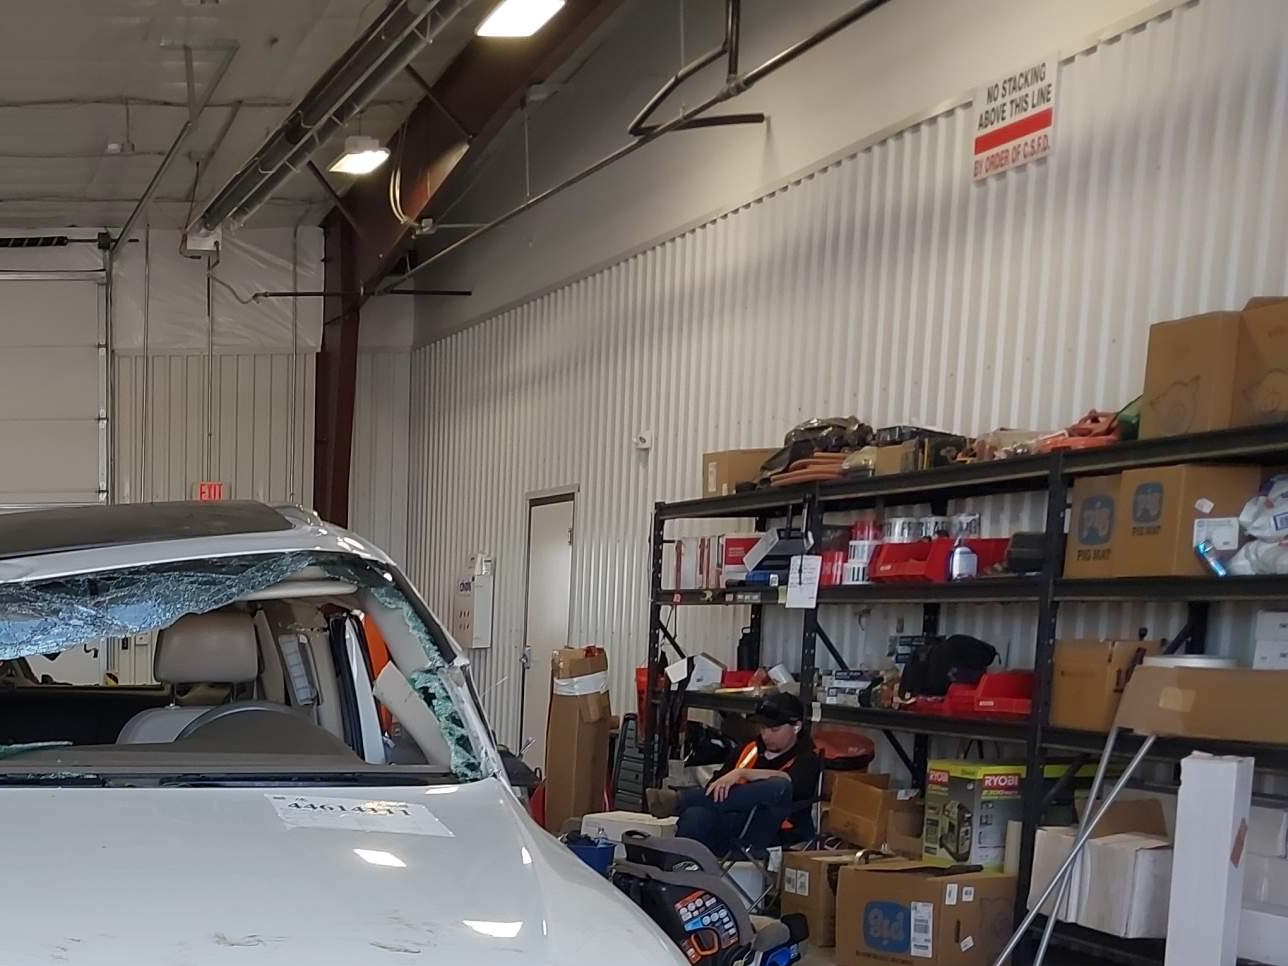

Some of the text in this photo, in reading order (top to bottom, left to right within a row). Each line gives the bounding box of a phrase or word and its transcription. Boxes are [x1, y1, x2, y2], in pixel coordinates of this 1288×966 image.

[986, 62, 1046, 105] NO STACKING
[978, 83, 1052, 130] ABOVE THIS LINE
[974, 160, 983, 178] BY
[984, 148, 1010, 173] ORDER
[1011, 143, 1022, 163] OF
[199, 483, 223, 500] EXIT
[984, 775, 1019, 787] RYOBI
[288, 802, 411, 816] 44614111
